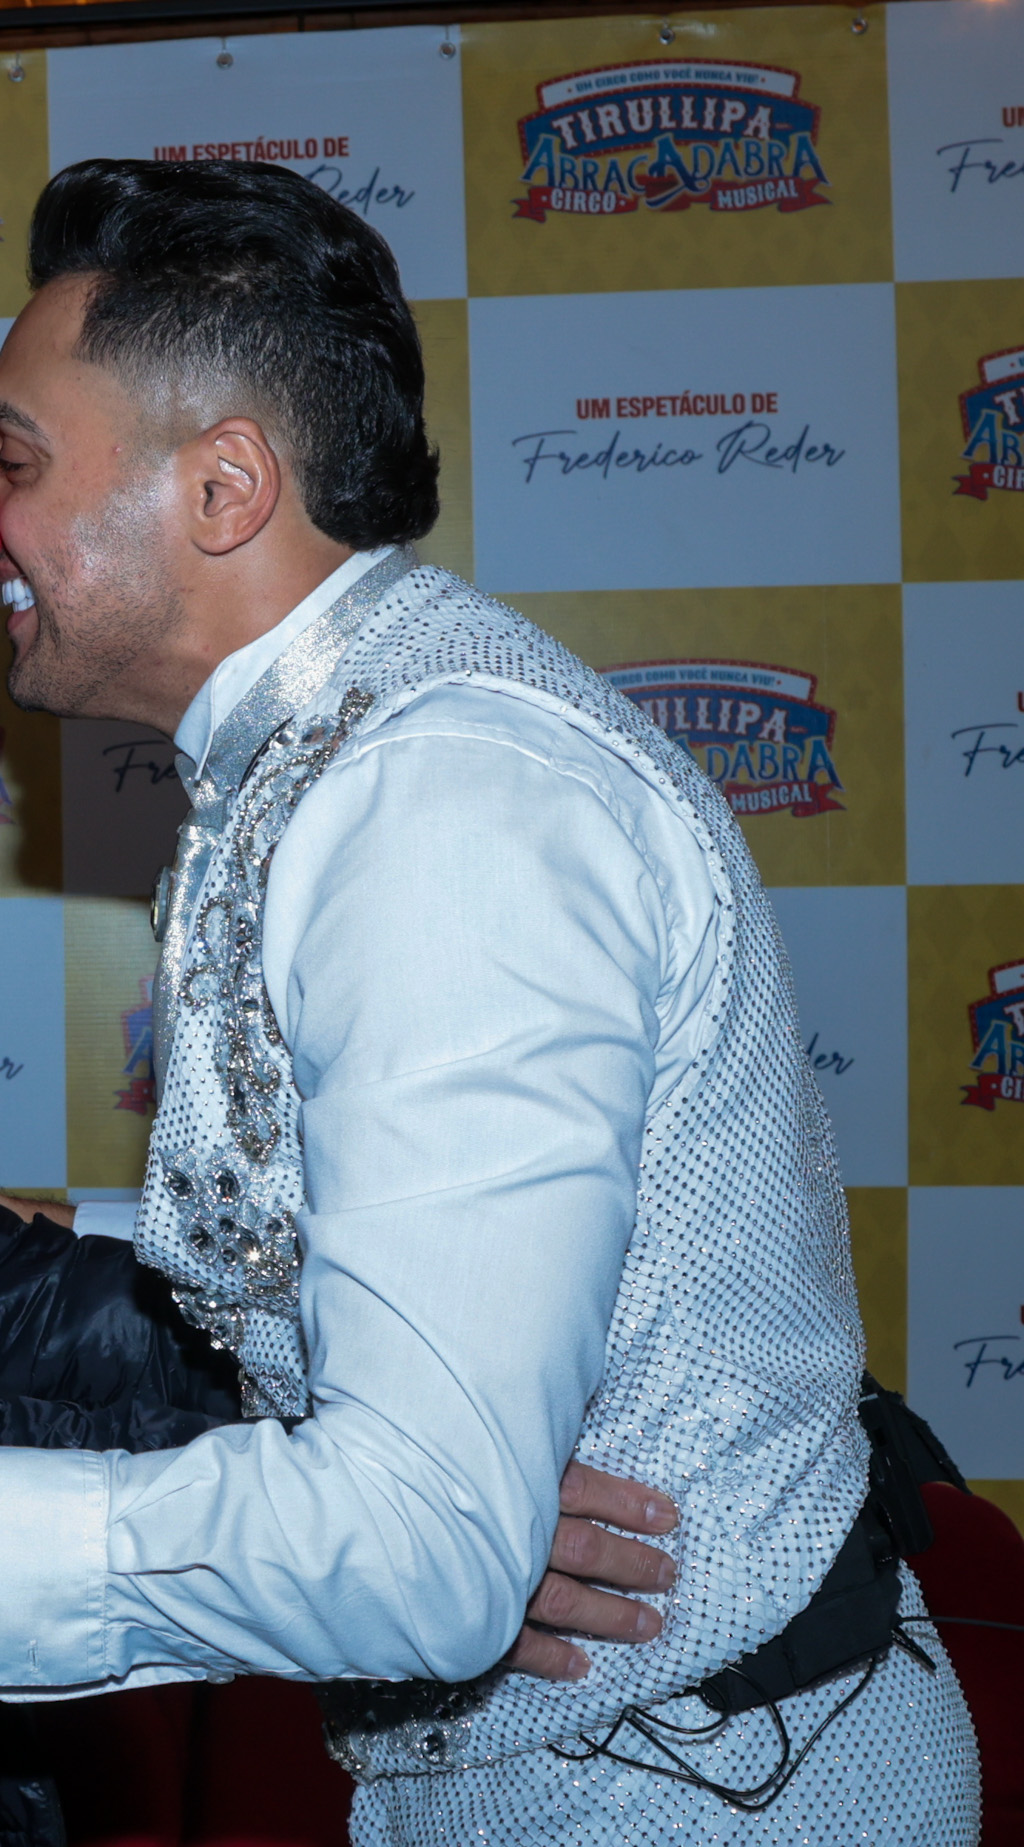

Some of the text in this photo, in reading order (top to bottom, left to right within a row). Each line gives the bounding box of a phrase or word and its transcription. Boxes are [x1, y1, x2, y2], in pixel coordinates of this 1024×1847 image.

[552, 95, 772, 150] TIRULLIPA
[323, 137, 350, 158] DE
[521, 132, 831, 208] ABRACADABRA
[551, 179, 799, 214] CIRCO MUSICAL
[577, 390, 779, 420] UM ESPETÁCULO DE
[512, 420, 846, 484] Frederico Reder
[640, 697, 787, 743] ULLIPA
[731, 783, 813, 811] MUSICAL
